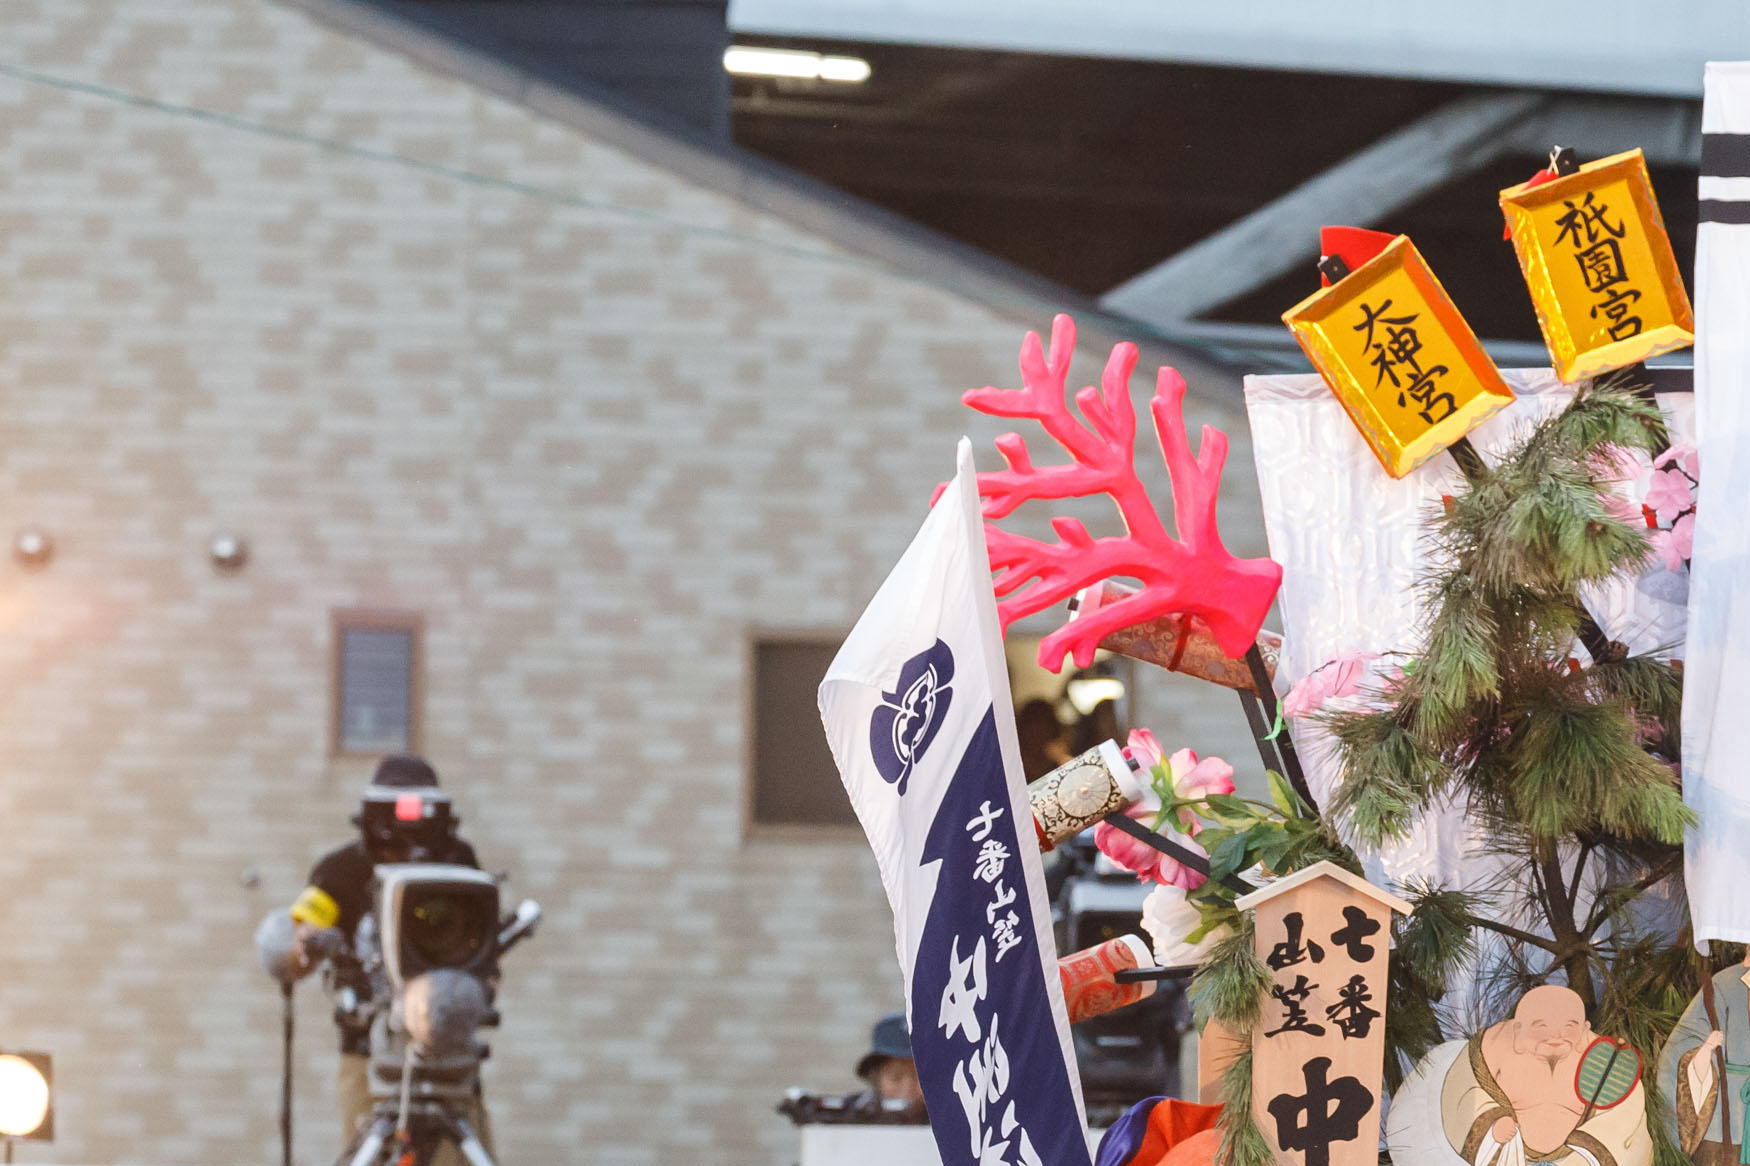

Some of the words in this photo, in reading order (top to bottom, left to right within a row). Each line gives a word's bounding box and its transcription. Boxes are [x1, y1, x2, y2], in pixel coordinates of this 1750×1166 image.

[1553, 191, 1643, 343] 祇園宮
[1353, 299, 1457, 425] 大神宮
